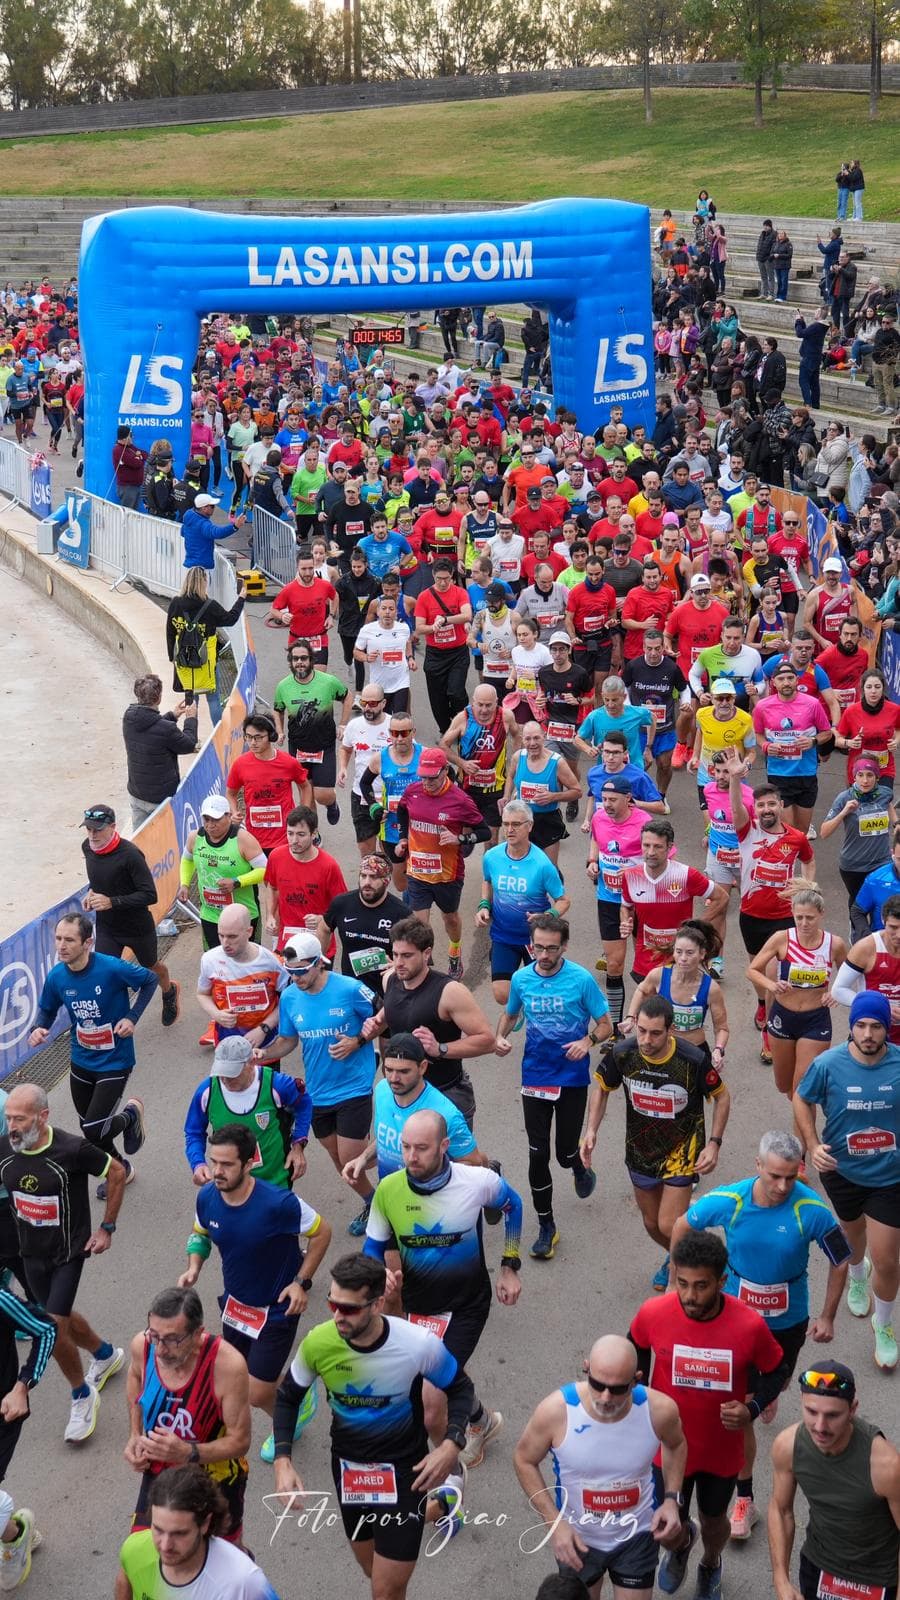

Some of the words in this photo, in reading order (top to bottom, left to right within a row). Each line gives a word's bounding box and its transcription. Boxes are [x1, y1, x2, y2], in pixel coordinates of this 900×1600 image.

[248, 241, 533, 286] LASANSI.COM
[593, 333, 648, 394] LS
[118, 354, 184, 416] LS
[593, 389, 650, 405] LASANSI.COM
[118, 417, 183, 428] LASANSI.COM
[866, 820, 885, 829] ANA
[416, 860, 436, 868] TONI
[497, 875, 528, 893] ERB
[360, 955, 381, 969] 829
[71, 1000, 99, 1011] CURSA
[674, 1013, 696, 1024] 805
[377, 1122, 403, 1148] ER
[856, 1136, 887, 1144] GUILLEM
[22, 1203, 49, 1214] EDUARDO
[747, 1294, 779, 1305] HUGO
[684, 1363, 720, 1375] SAMUEL
[353, 1475, 384, 1485] JARED
[592, 1495, 630, 1505] MIGUEL
[832, 1576, 872, 1595] MANUEL
